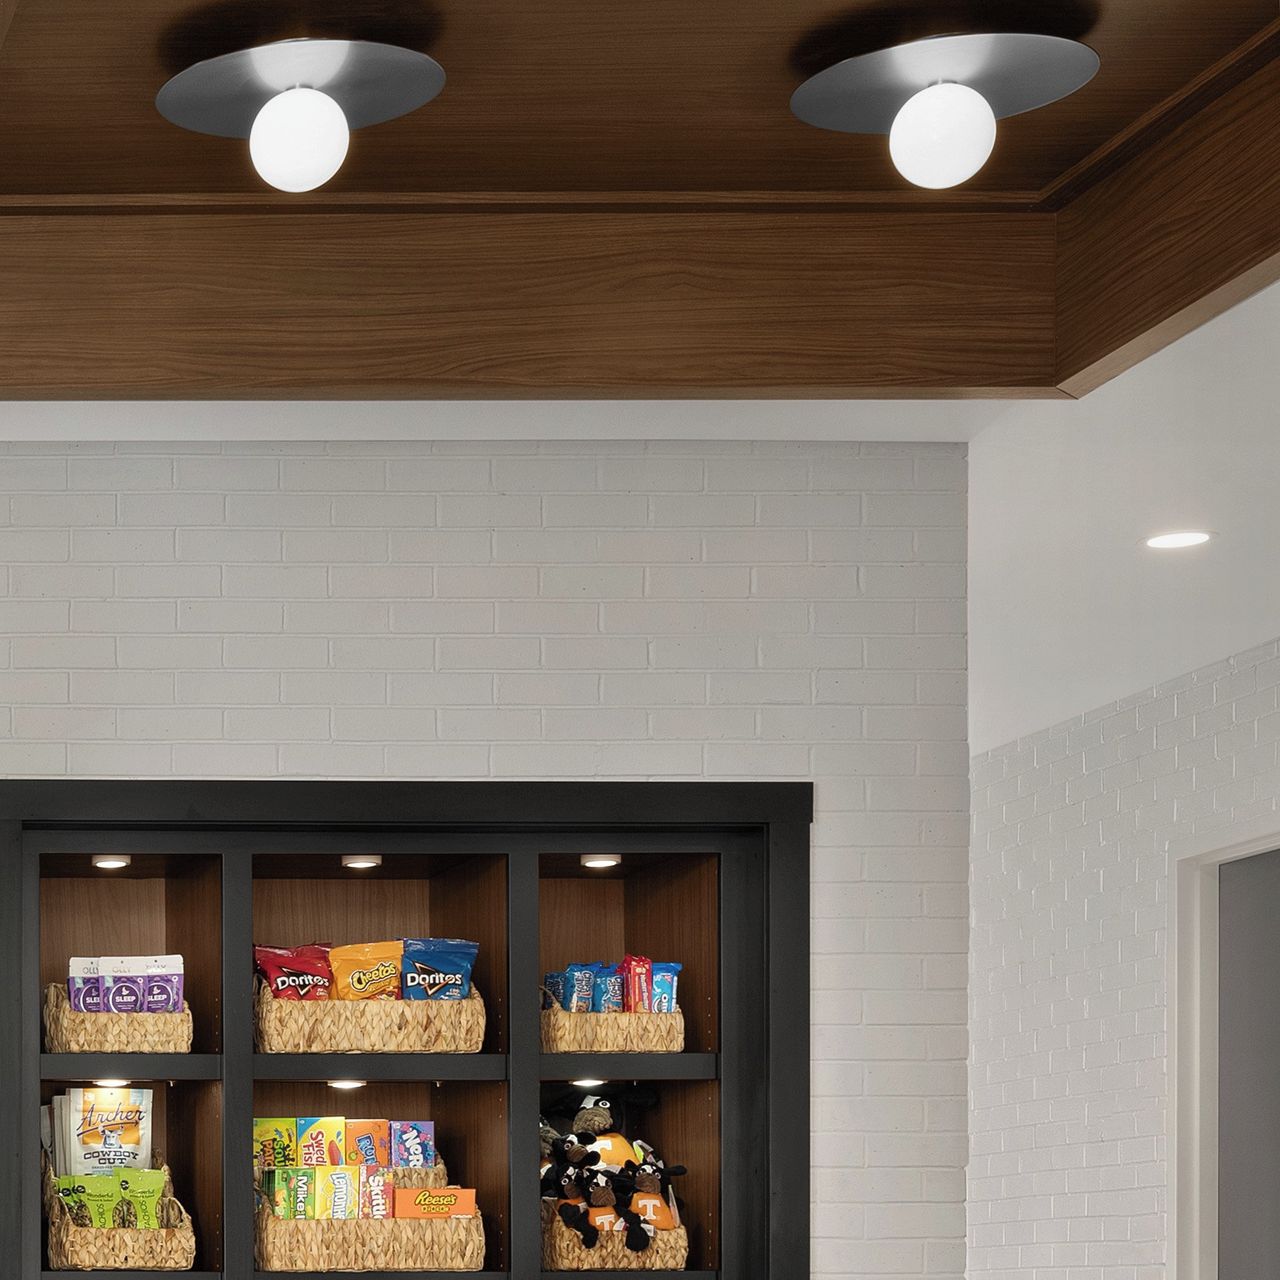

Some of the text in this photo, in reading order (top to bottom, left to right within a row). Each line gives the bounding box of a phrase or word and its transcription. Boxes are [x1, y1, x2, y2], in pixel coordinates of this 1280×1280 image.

[276, 974, 330, 990] Doritos
[351, 962, 397, 990] Cheetos
[406, 972, 463, 987] Doritos
[76, 1102, 146, 1132] Archer
[83, 1150, 139, 1160] COWBOY
[98, 1157, 127, 1165] CUT
[414, 1190, 457, 1205] Reese's
[638, 1199, 661, 1220] T
